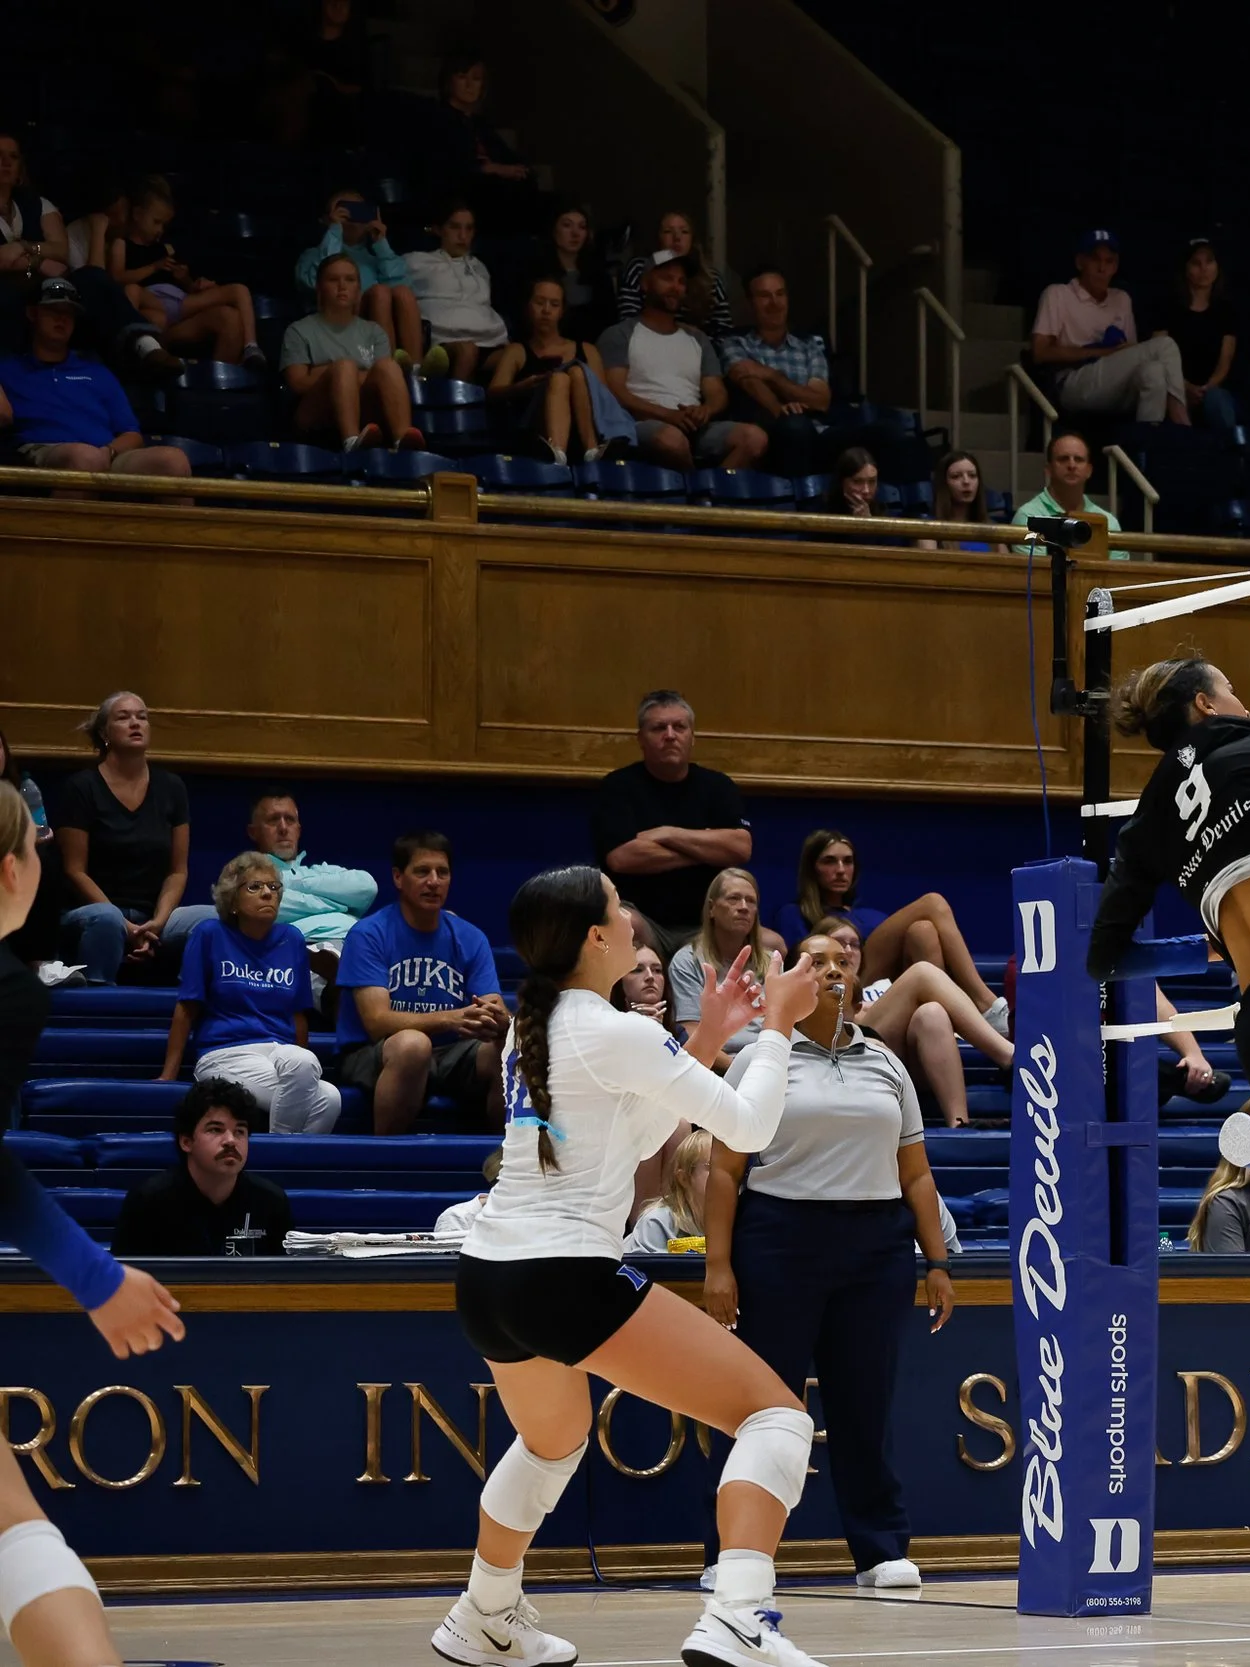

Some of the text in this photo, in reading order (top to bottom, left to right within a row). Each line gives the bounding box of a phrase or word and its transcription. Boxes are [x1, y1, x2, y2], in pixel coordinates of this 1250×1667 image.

[1175, 763, 1212, 842] 9
[1018, 900, 1057, 974] D
[221, 960, 294, 986] Duke 100
[388, 957, 464, 1002] DUKE
[1018, 1033, 1068, 1550] Blue Devils
[1105, 1313, 1128, 1495] sports imports
[1088, 1518, 1141, 1573] D
[1086, 1597, 1142, 1607] (800) 556-3198
